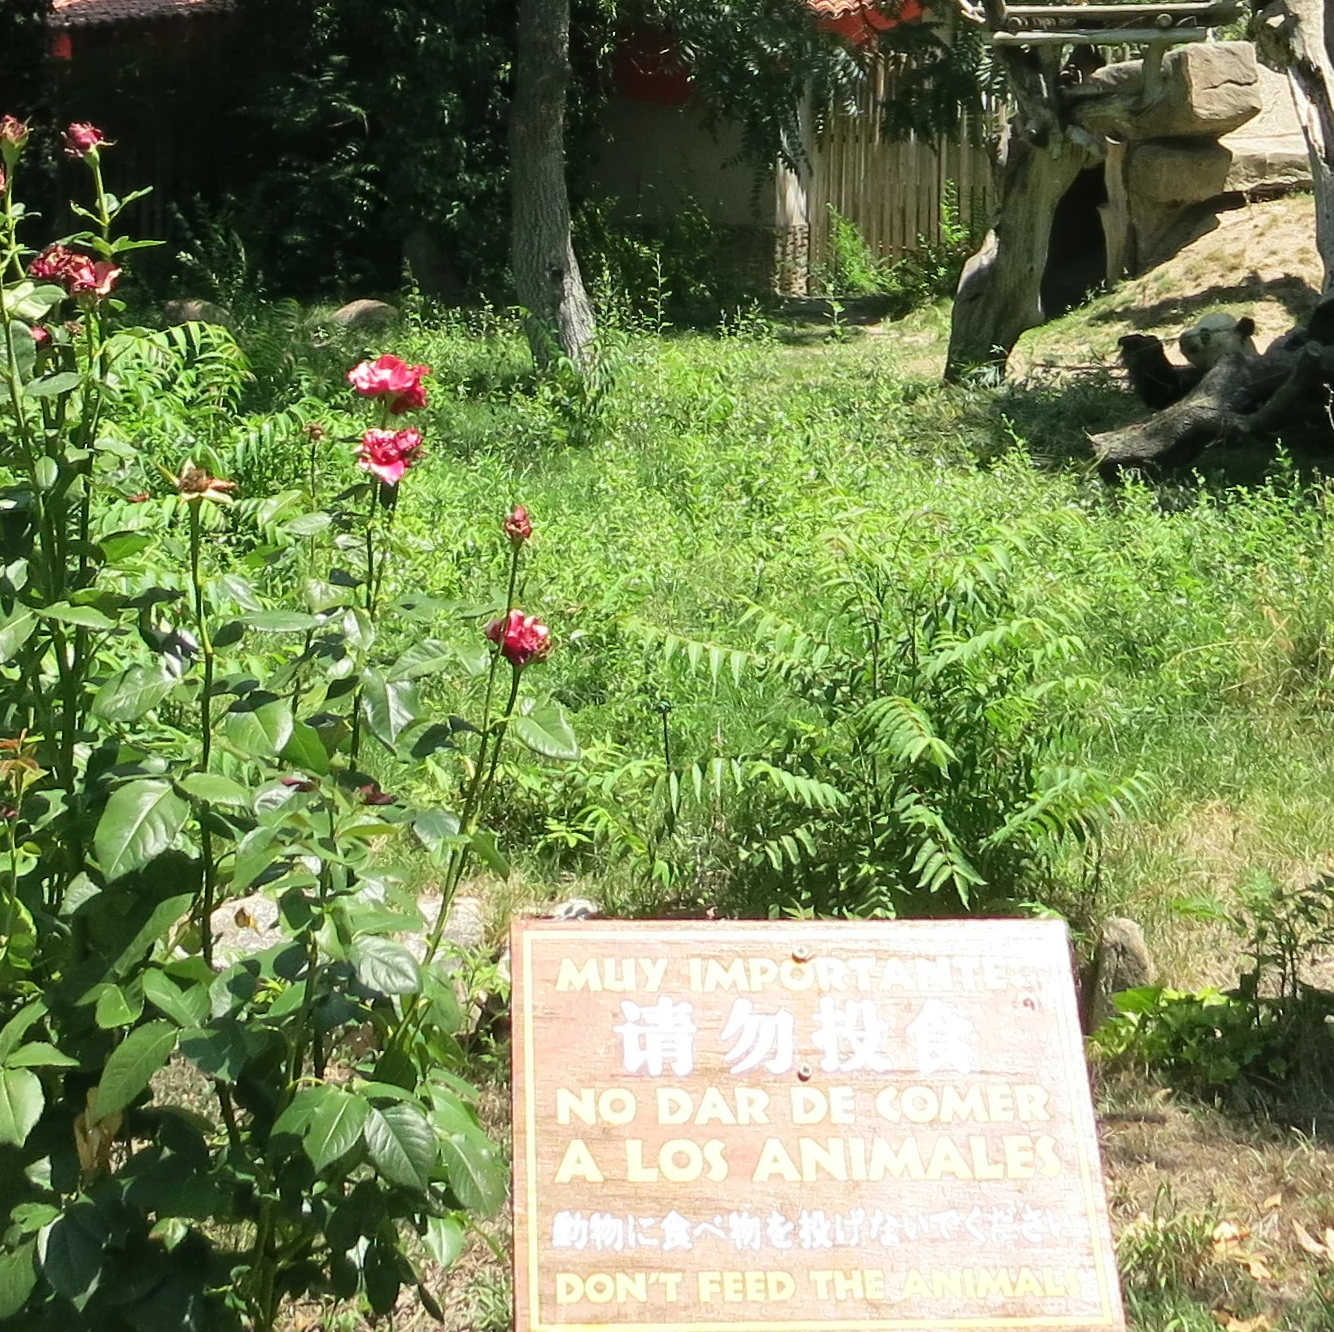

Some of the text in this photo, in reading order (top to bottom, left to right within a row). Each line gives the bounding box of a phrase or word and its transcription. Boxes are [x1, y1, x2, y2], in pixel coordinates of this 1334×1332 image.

[555, 957, 668, 993] MUY
[613, 994, 977, 1076] 请勿投食
[555, 1083, 1050, 1125] NO DAR DE COMER
[553, 1133, 1062, 1184] A LOS ANIMALES
[555, 1266, 1080, 1304] DON'T FEED THE ANIMALS
